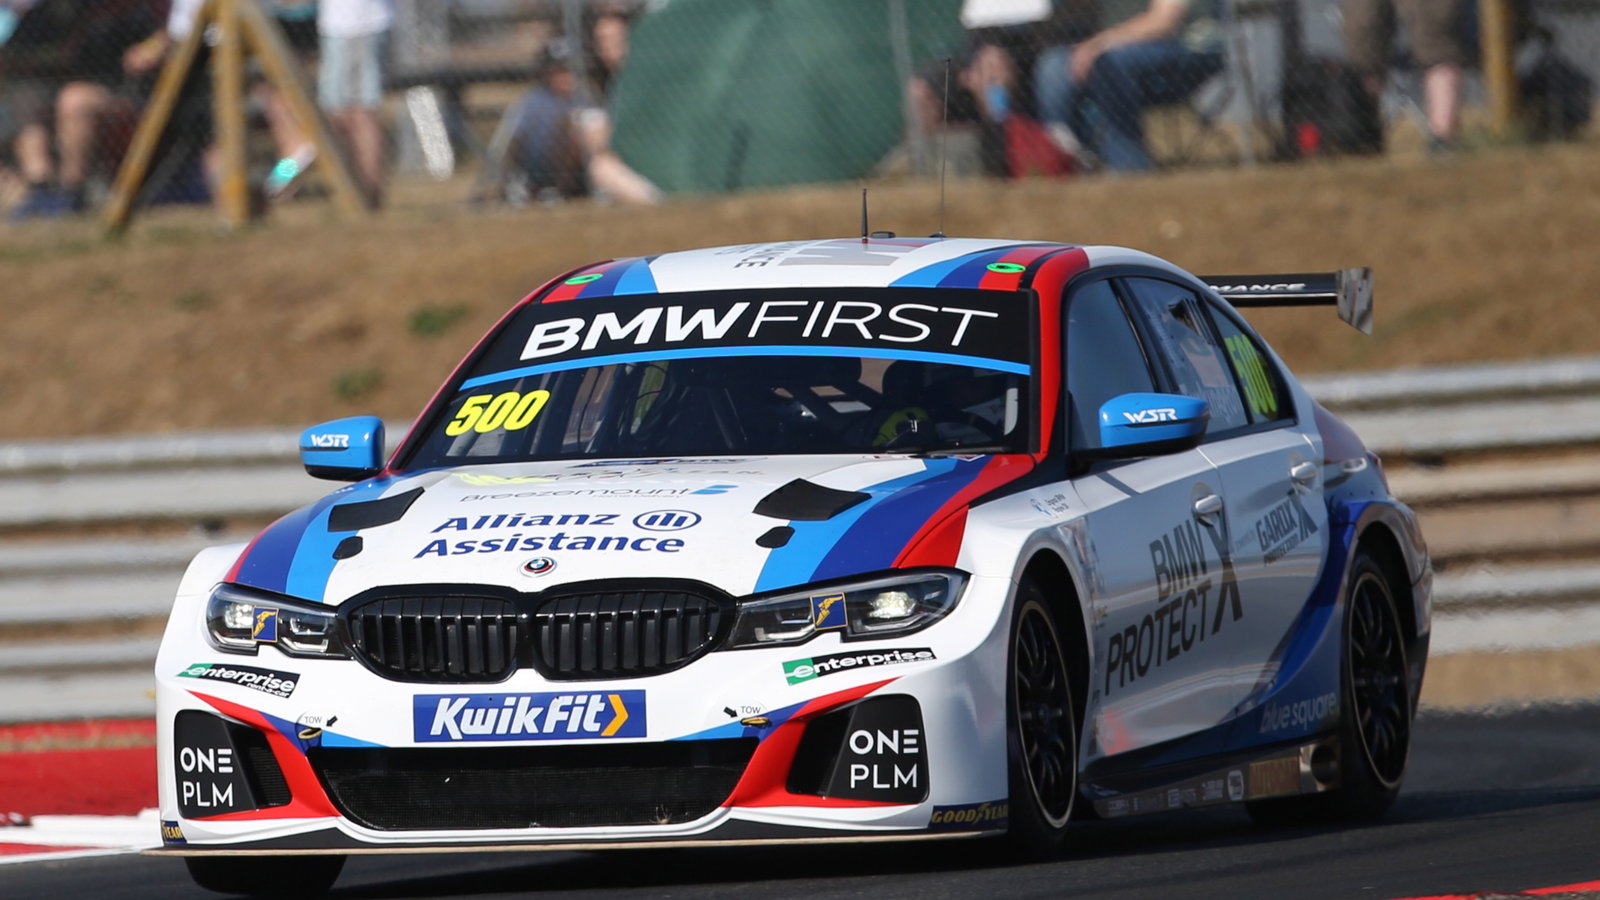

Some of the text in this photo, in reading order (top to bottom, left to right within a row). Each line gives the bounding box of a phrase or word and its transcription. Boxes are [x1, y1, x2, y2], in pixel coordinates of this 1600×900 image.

[445, 390, 551, 437] 500
[1123, 408, 1178, 423] WSR
[311, 434, 350, 448] WSR
[430, 513, 620, 533] Allianz
[413, 532, 685, 559] Assistance
[1149, 519, 1207, 603] BMW
[1105, 579, 1212, 696] PROTECT
[784, 651, 932, 678] enterprise
[182, 667, 295, 692] enterprise
[304, 716, 322, 724] TOW
[741, 706, 761, 714] TOW
[849, 729, 919, 754] ONE
[180, 747, 233, 773] ONE
[850, 763, 917, 788] PLM
[182, 781, 233, 807] PLM
